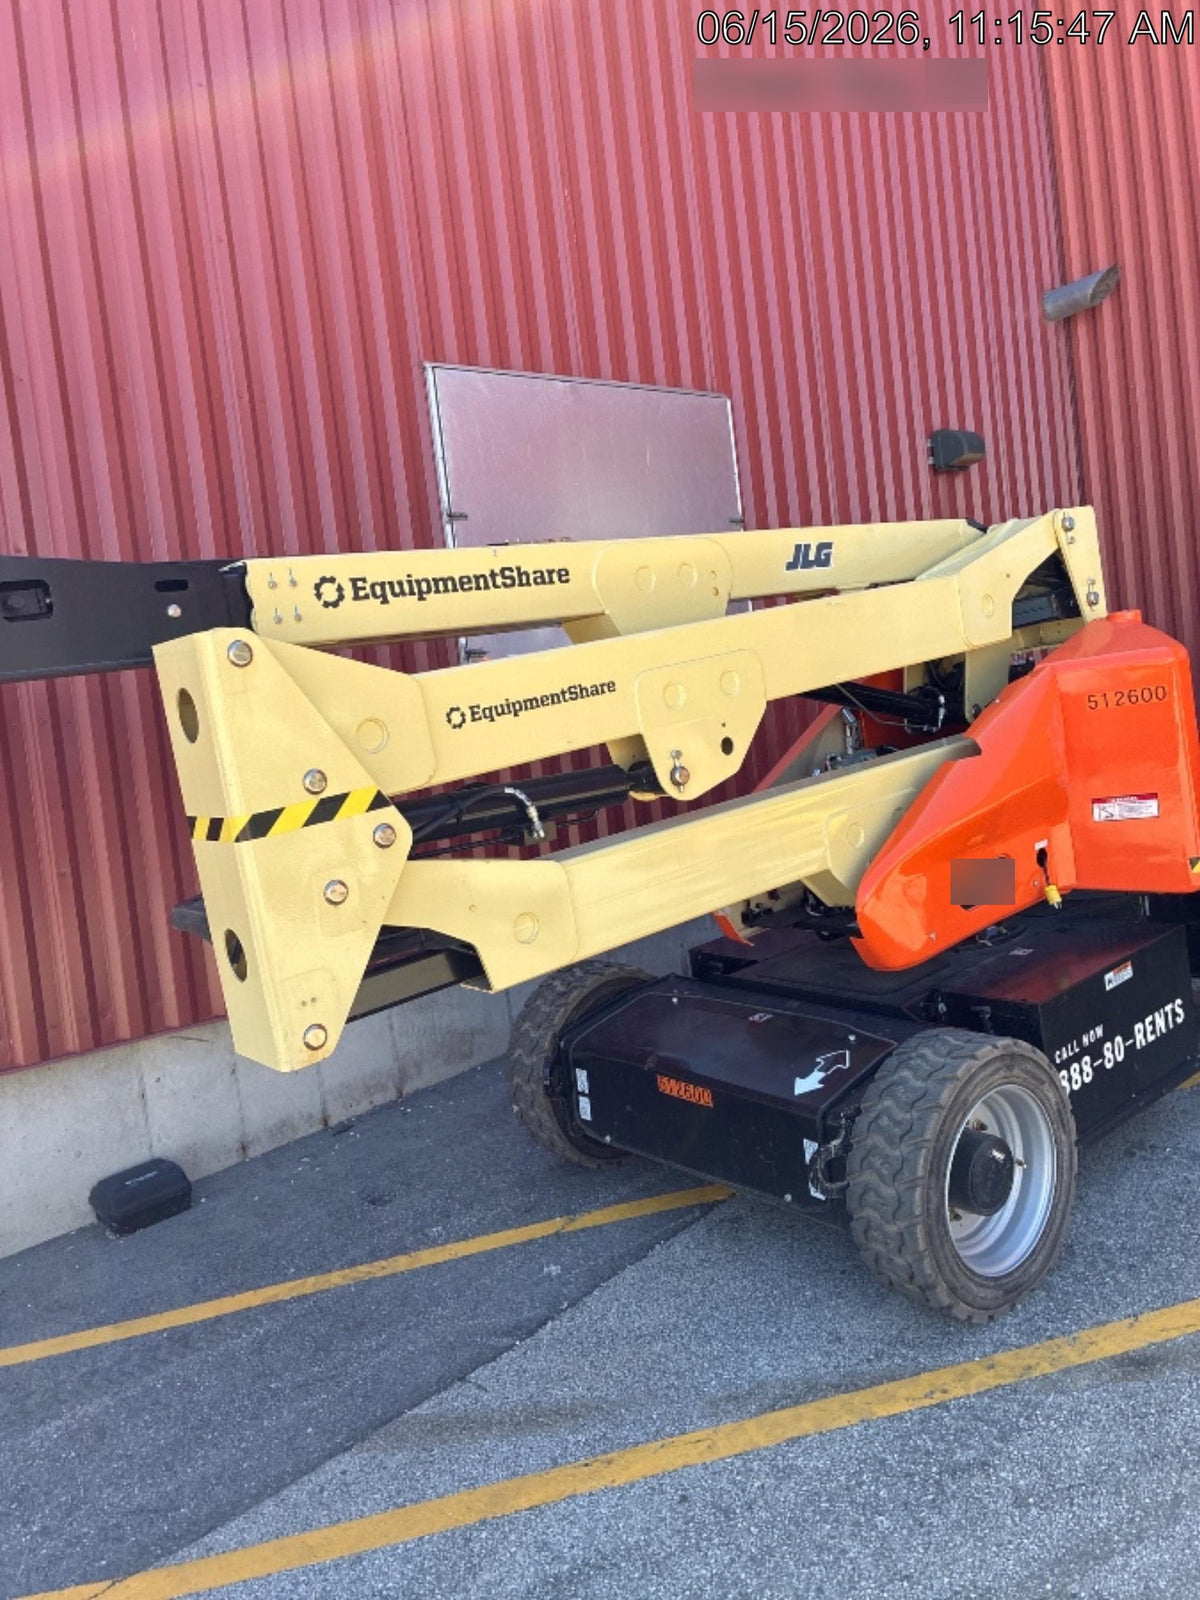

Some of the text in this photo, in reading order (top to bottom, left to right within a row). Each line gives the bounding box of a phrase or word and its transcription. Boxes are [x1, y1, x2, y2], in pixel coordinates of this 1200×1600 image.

[785, 541, 834, 571] JLG
[349, 566, 571, 604] EquipmentShare
[468, 680, 616, 722] EquipmentShare
[1087, 685, 1167, 710] 512600
[1054, 1024, 1103, 1064] CALL NOW
